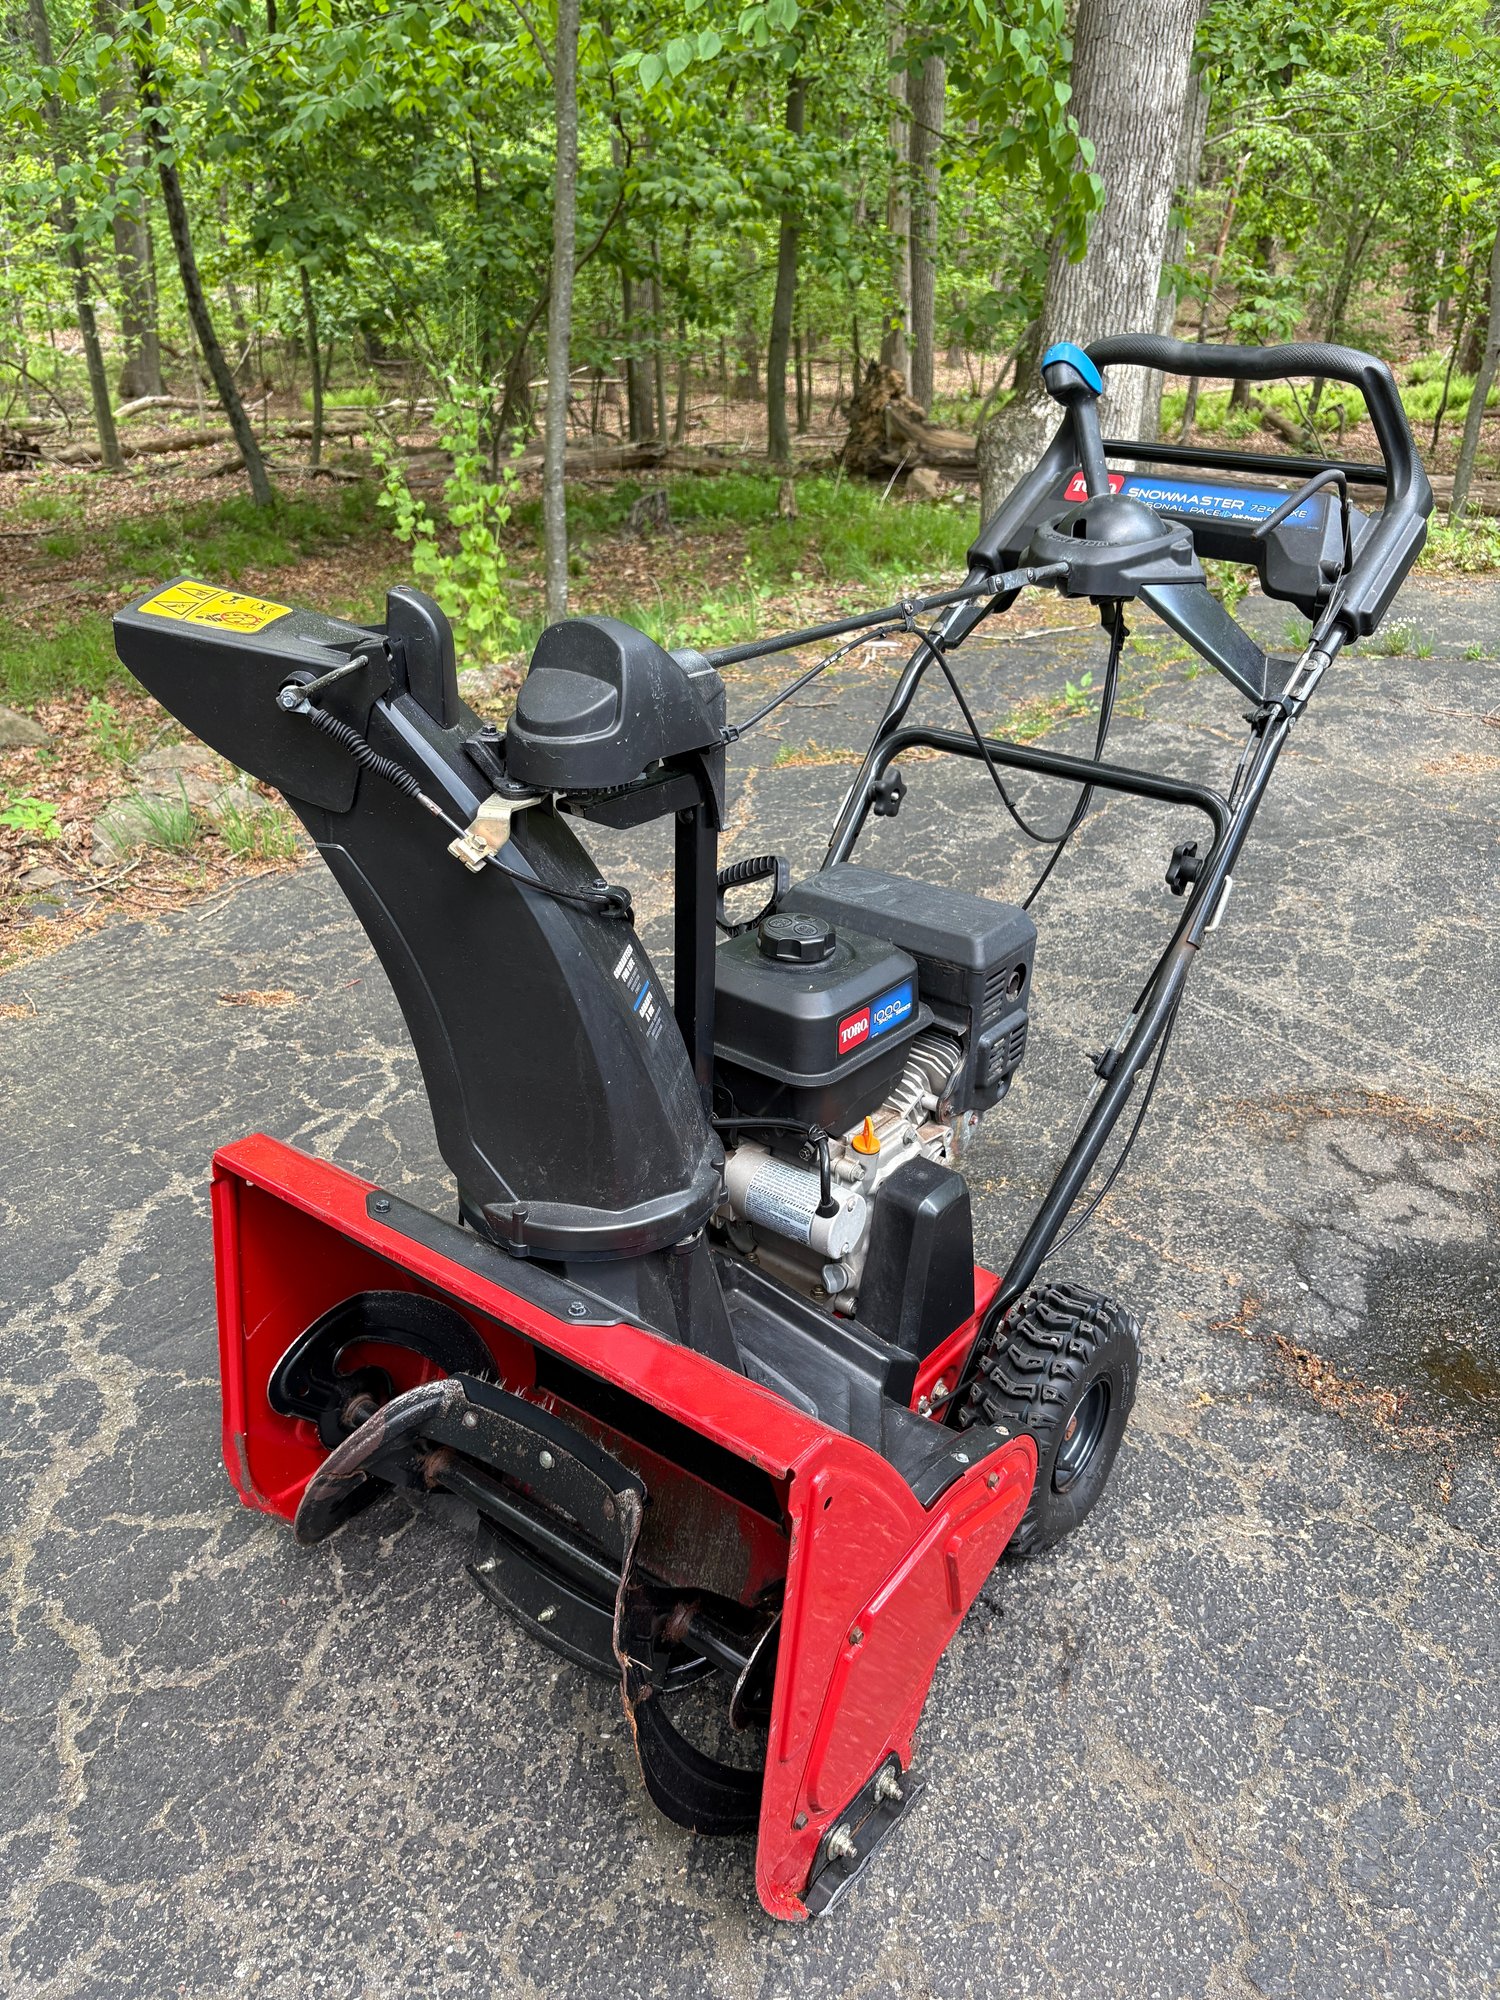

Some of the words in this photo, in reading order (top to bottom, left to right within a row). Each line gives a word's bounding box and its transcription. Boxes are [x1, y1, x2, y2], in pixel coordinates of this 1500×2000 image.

[1127, 487, 1245, 510] SNOWMASTER
[1250, 504, 1276, 514] 724
[1189, 506, 1221, 517] PACE
[873, 1000, 902, 1024] 1000
[841, 1018, 868, 1043] TORO
